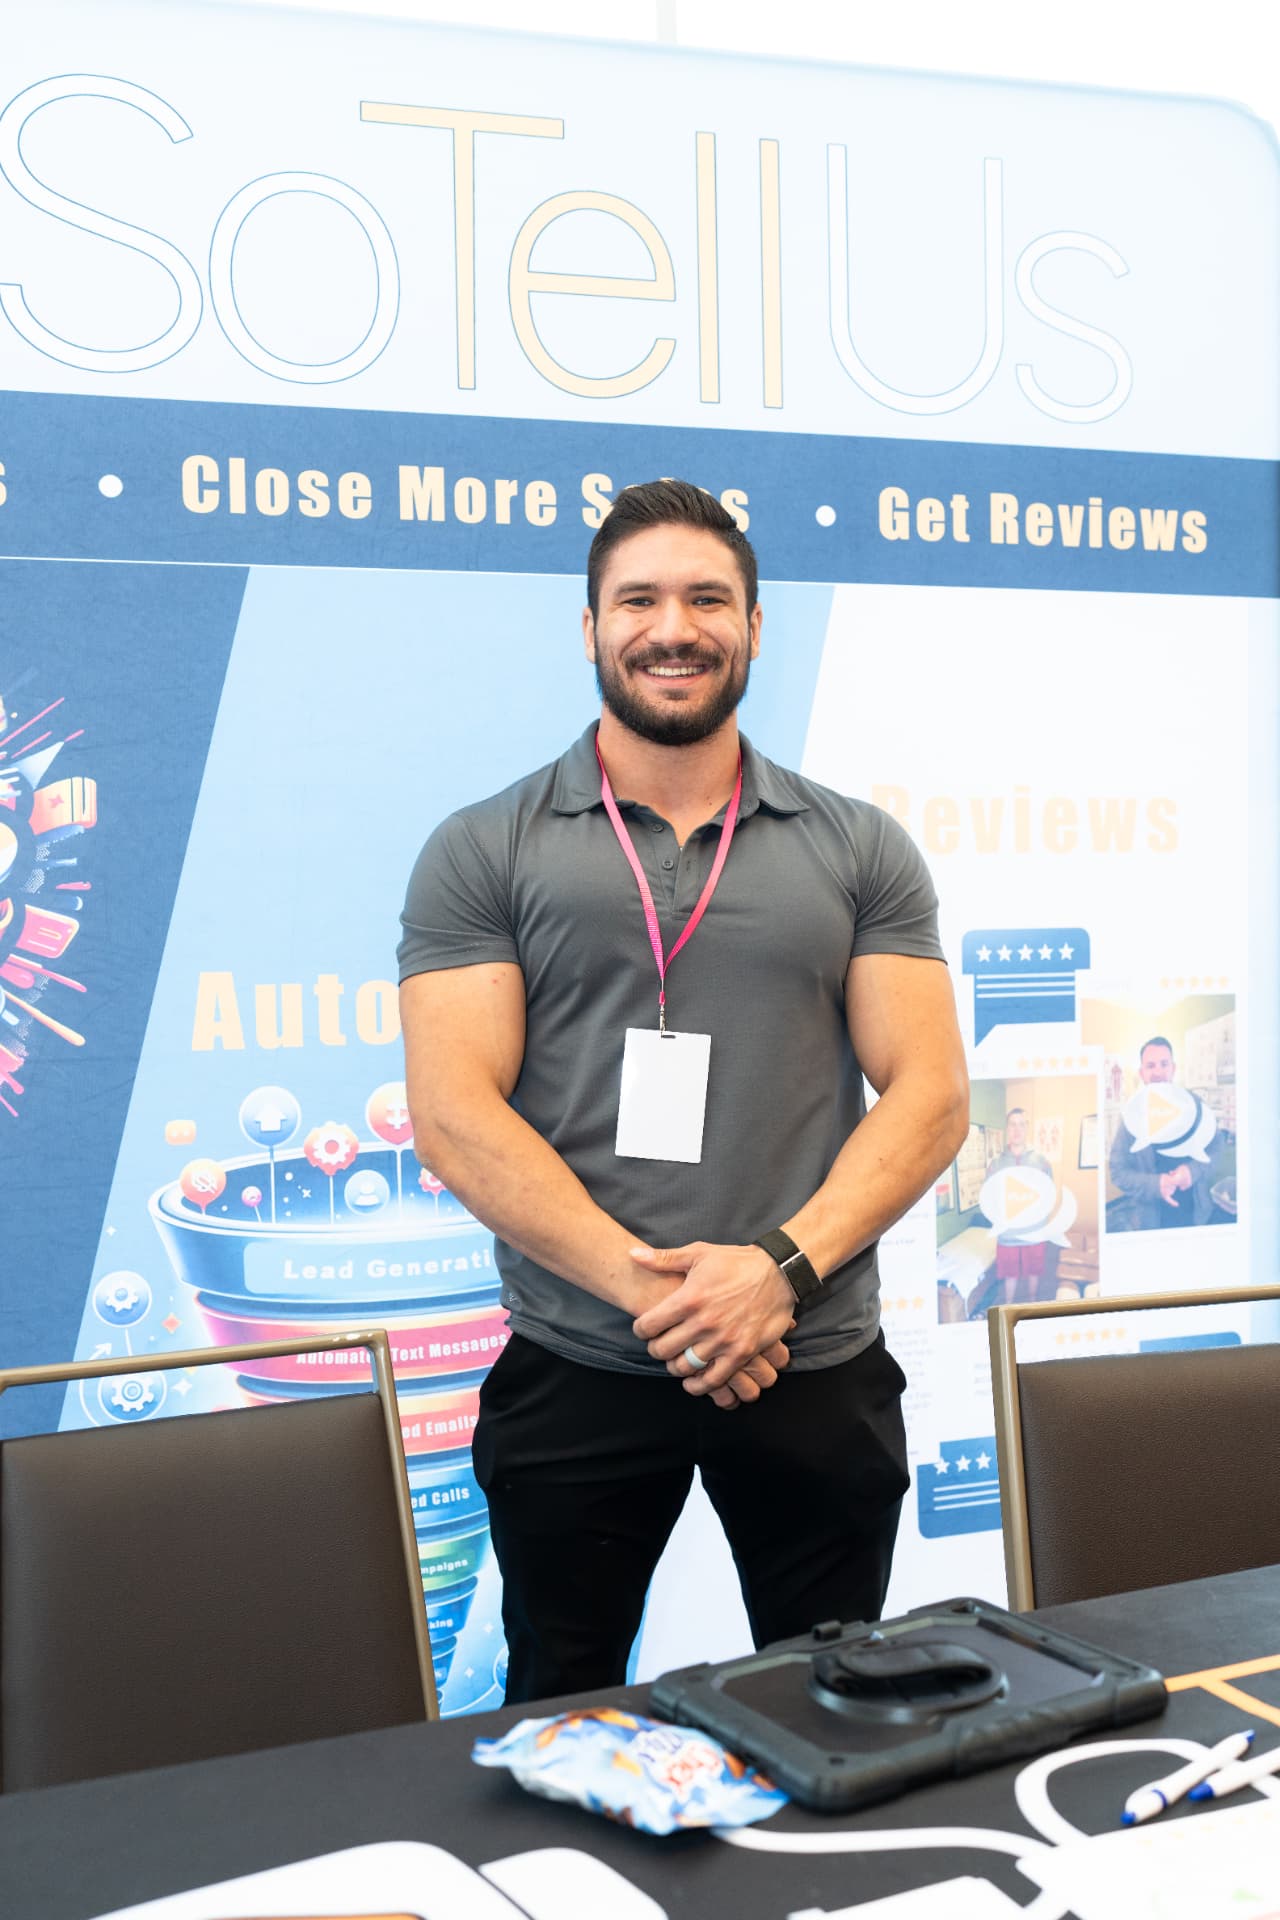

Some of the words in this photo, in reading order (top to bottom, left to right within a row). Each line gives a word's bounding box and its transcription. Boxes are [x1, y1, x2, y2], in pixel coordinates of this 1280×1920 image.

[181, 454, 372, 519] Close
[398, 465, 558, 527] More
[878, 486, 970, 542] Get
[990, 492, 1208, 554] Reviews
[283, 1259, 353, 1280] Lead
[366, 1248, 491, 1278] Generati
[392, 1347, 425, 1362] Text
[428, 1334, 508, 1359] Messages
[426, 1415, 479, 1436] Emails
[432, 1487, 470, 1505] Calls
